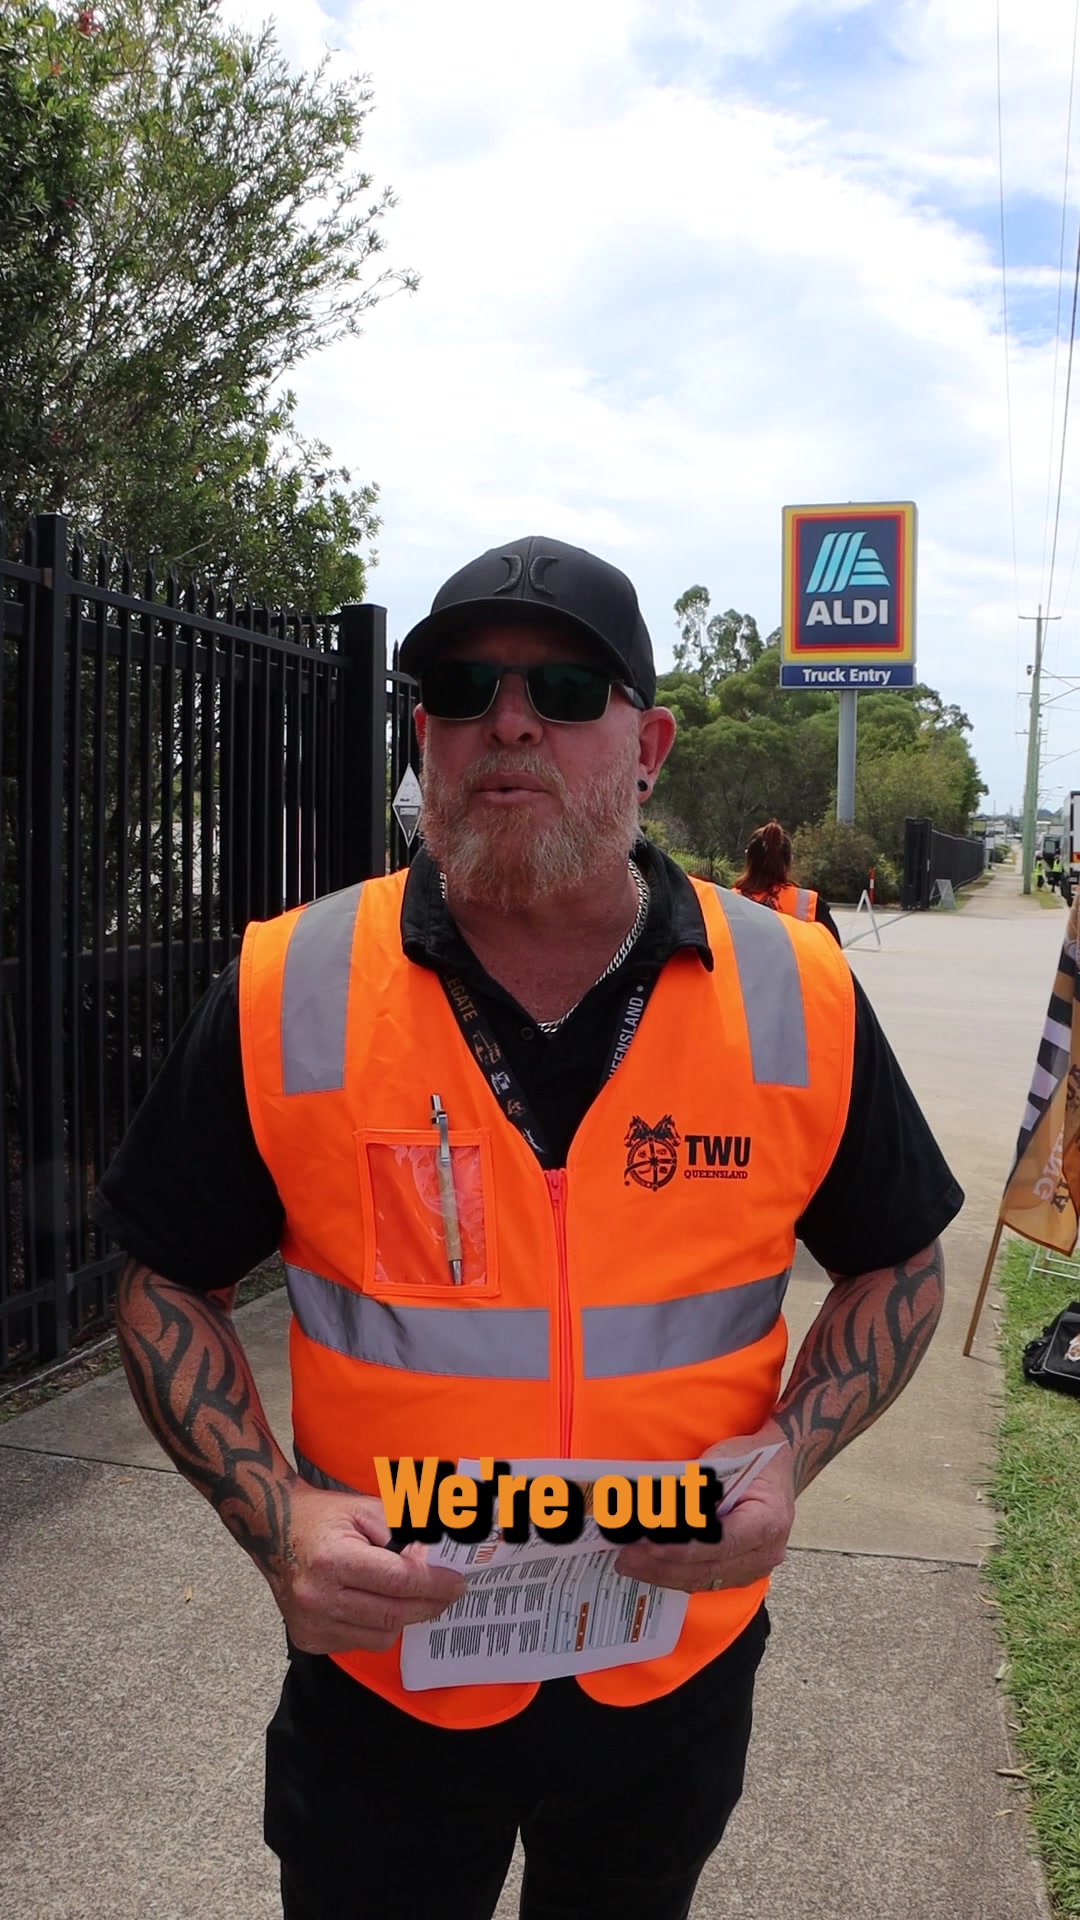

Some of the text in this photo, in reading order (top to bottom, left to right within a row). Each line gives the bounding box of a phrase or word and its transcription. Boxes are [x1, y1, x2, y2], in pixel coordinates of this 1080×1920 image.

[806, 600, 889, 625] ALDI
[803, 668, 891, 685] Truck Entry
[685, 1135, 751, 1167] TWU
[684, 1170, 748, 1179] QUEENSLAND
